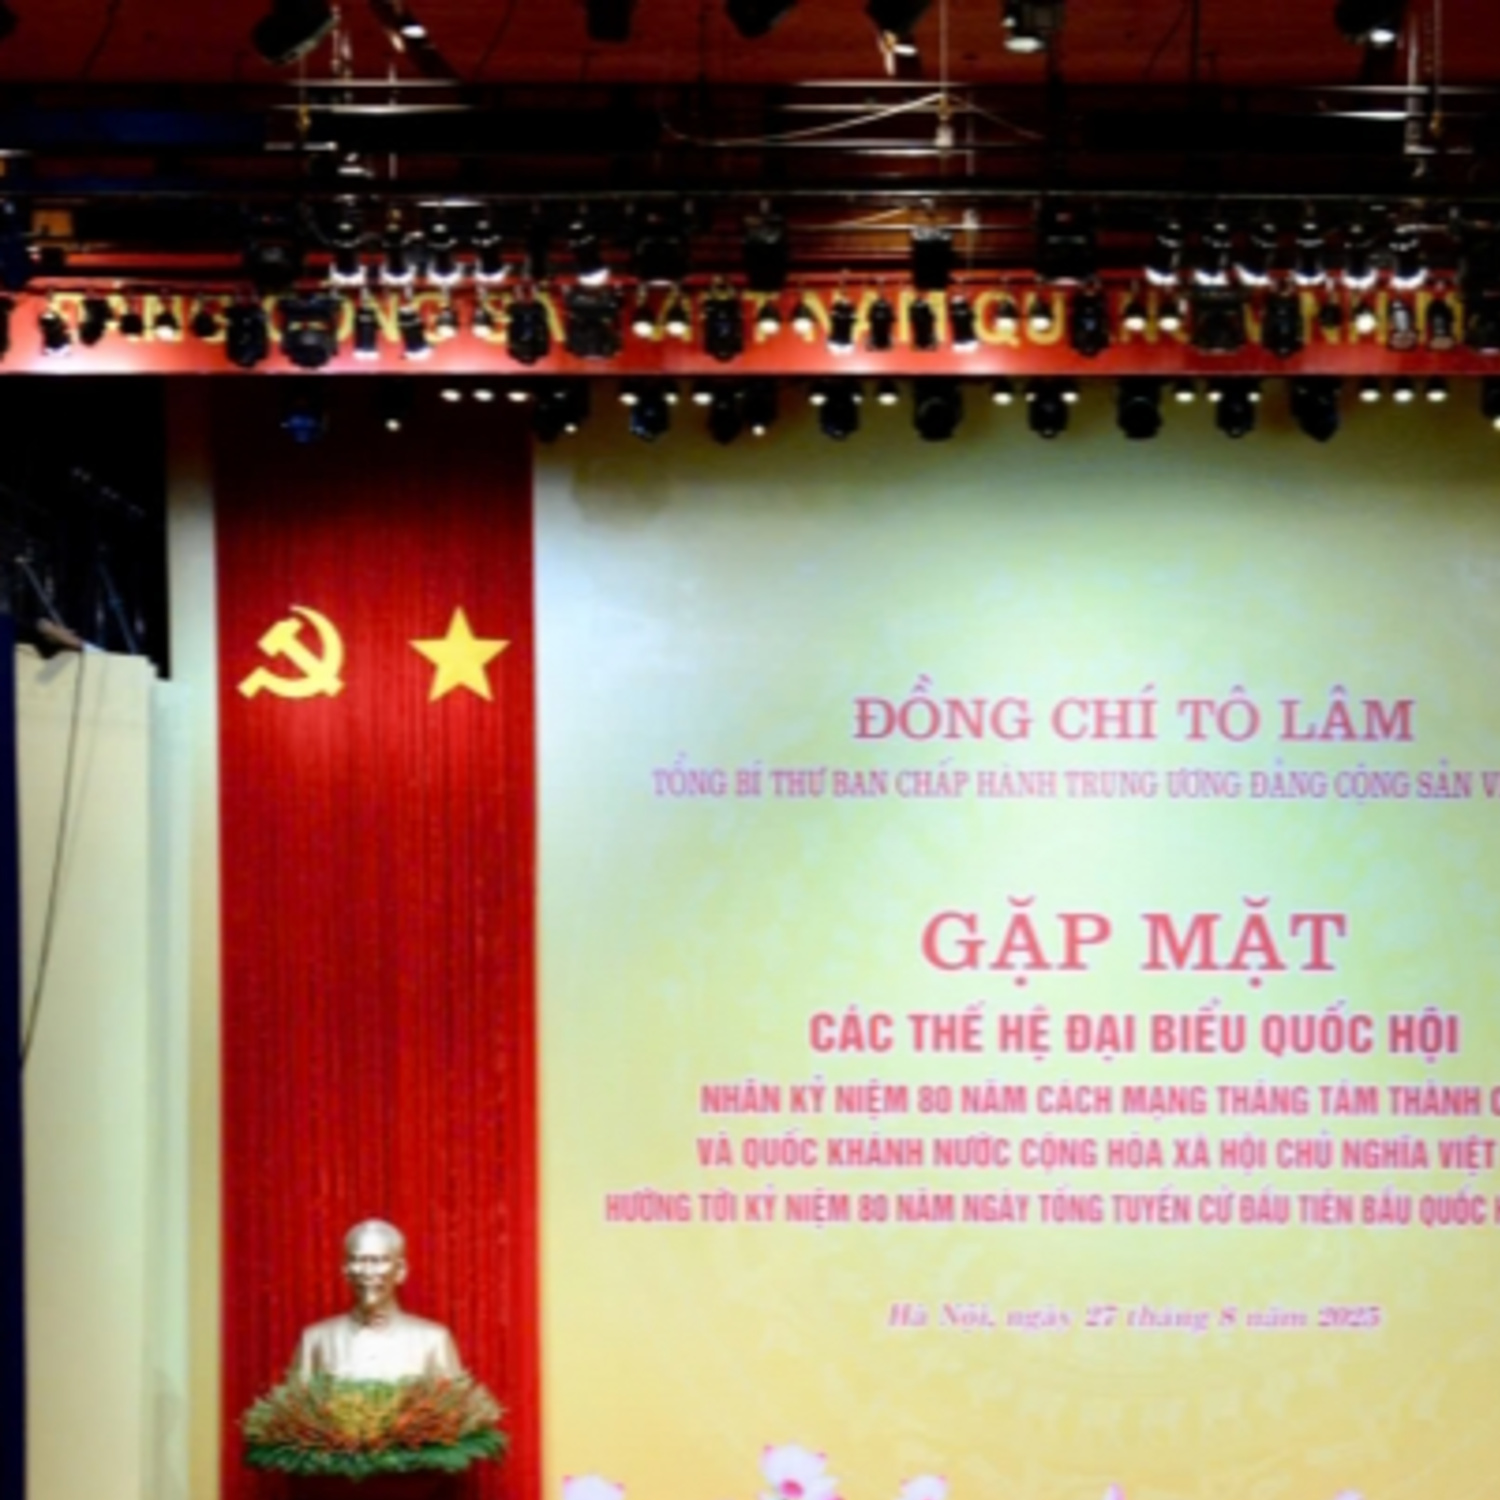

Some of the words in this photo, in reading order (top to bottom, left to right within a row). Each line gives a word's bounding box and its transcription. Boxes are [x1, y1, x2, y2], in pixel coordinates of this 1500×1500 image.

[853, 674, 1033, 740] ĐỒNG
[1051, 684, 1158, 741] CHÍ
[1178, 685, 1261, 741] TÔ
[1280, 684, 1415, 741] LÂM
[921, 896, 1113, 987] GẶP
[1141, 897, 1347, 988] MẶT
[809, 1004, 895, 1053] CÁC
[907, 1001, 984, 1053] THẾ
[998, 1006, 1051, 1061] HỆ
[1064, 1013, 1137, 1061] ĐẠI
[1149, 999, 1247, 1054] BIỂU
[1260, 1000, 1375, 1057] QUỐC
[1388, 1006, 1460, 1063] HỘI
[917, 1085, 953, 1114] 80
[857, 1194, 890, 1223] 80
[1084, 1304, 1120, 1327] 27
[1317, 1305, 1383, 1328] 2025
